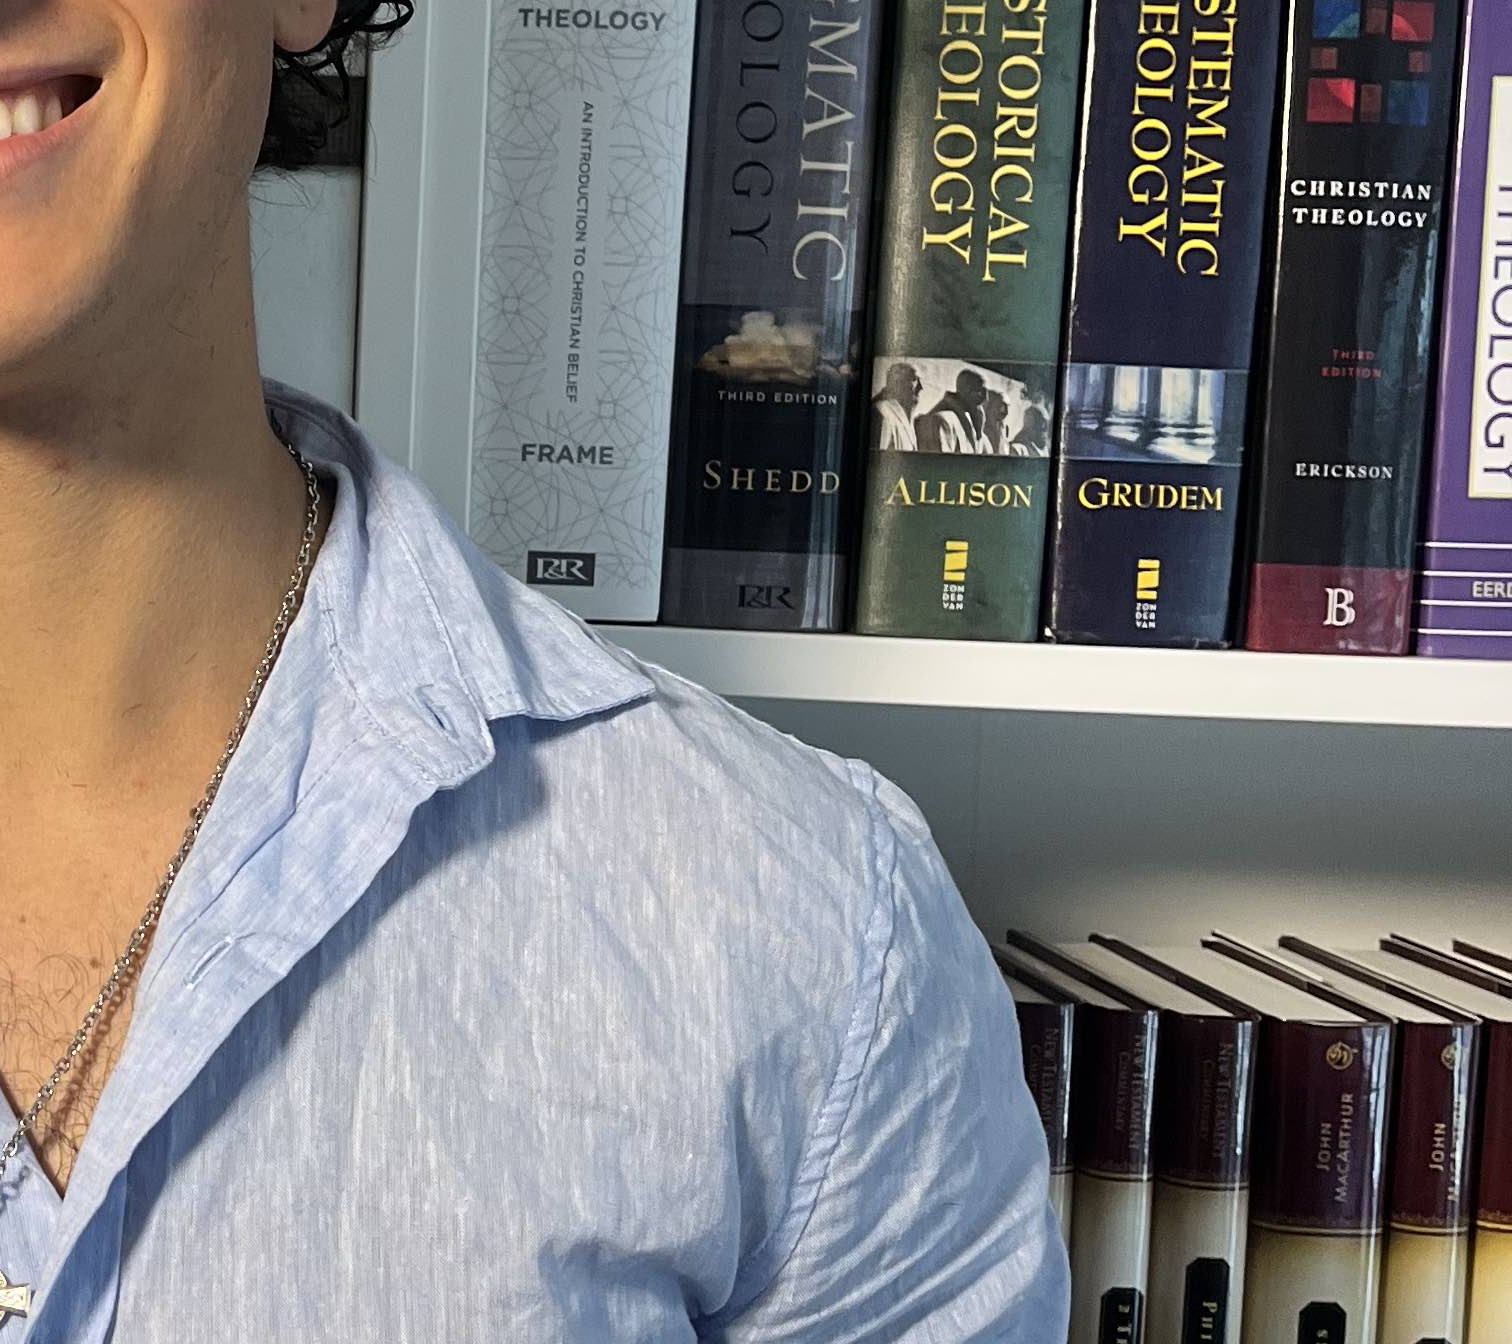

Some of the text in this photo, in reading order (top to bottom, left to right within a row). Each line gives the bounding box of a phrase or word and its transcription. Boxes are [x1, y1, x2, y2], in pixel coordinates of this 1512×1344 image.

[518, 5, 668, 32] THEOLOGY
[1291, 180, 1432, 199] CHRISTIAN
[1293, 208, 1427, 228] THEOLOGY
[566, 101, 595, 403] AN INTRODUCTION TO CHRISTIAN BELIEF
[718, 389, 837, 405] THIRD EDITION
[521, 444, 614, 466] FRAME
[703, 460, 840, 496] SHEDD
[1294, 463, 1394, 479] ERICKSON
[886, 476, 1032, 508] ALLISON
[1078, 477, 1224, 511] GRUDEM
